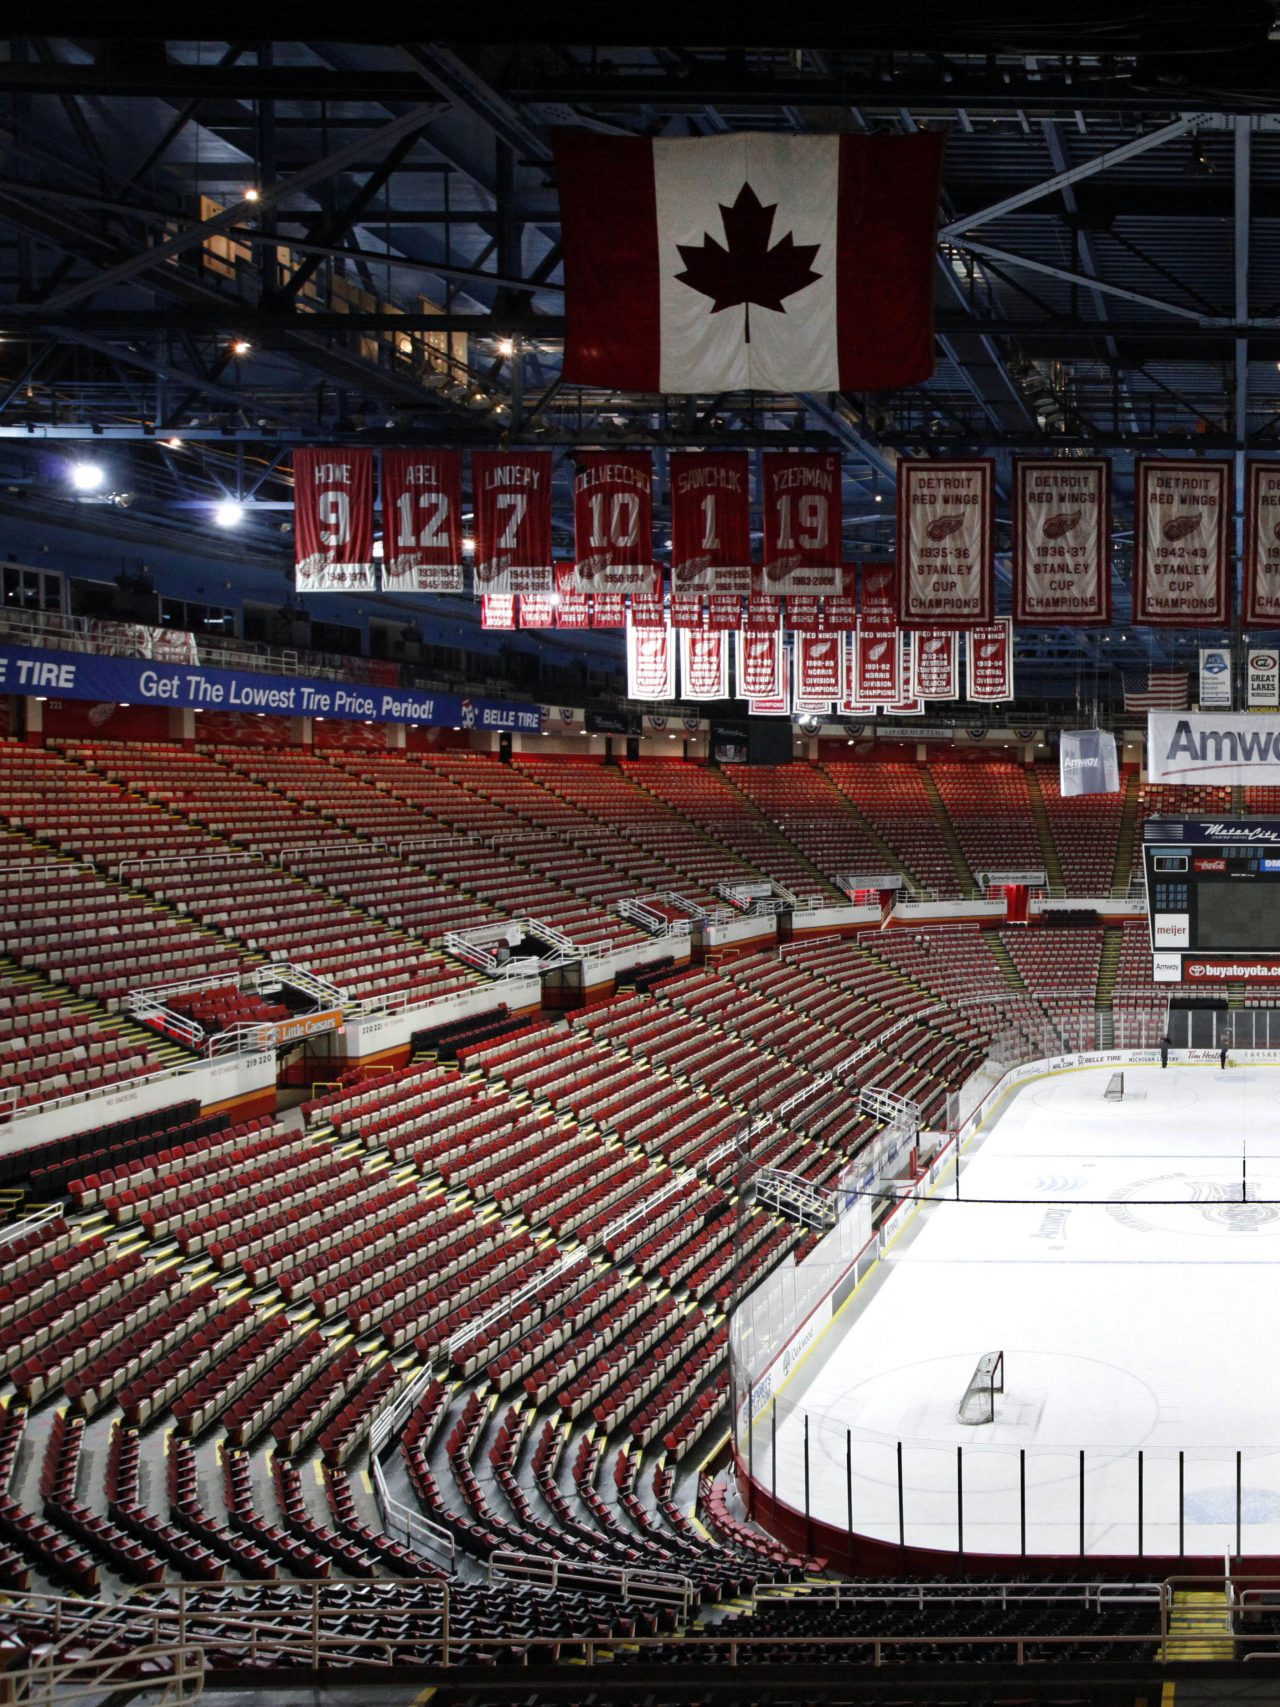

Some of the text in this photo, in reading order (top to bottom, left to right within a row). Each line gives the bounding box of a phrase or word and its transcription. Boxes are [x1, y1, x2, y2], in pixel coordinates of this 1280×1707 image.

[826, 458, 834, 470] C
[315, 465, 351, 484] HOWE
[406, 465, 437, 485] ABEL
[486, 466, 540, 490] LINDSAY
[576, 464, 650, 494] DELVECCHIO
[678, 467, 741, 493] SAWCHUK
[773, 468, 832, 492] YZERMAN
[919, 478, 972, 489] DETROIT
[1035, 476, 1089, 487] DETROIT
[1157, 478, 1210, 489] DETROIT
[912, 494, 979, 505] RED WINGS
[1028, 493, 1096, 503] RED WINGS
[1150, 494, 1217, 506] RED WINGS
[320, 491, 350, 545] 9
[397, 492, 449, 547] 12
[497, 494, 527, 548] 7
[589, 493, 640, 547] 10
[701, 495, 720, 549] 1
[776, 494, 828, 549] 19
[920, 548, 970, 559] 1935-36
[1037, 547, 1087, 557] 1936-37
[1156, 548, 1208, 558] 1942-43
[510, 570, 550, 579] 1944-1957
[918, 565, 973, 575] STANLEY
[1034, 564, 1089, 574] STANLEY
[1154, 565, 1209, 575] STANLEY
[933, 582, 957, 592] CUP
[1050, 581, 1074, 591] CUP
[1169, 582, 1194, 592] CUP
[911, 598, 979, 608] CHAMPIONS
[1028, 597, 1096, 608] CHAMPIONS
[1148, 598, 1215, 608] CHAMPIONS
[16, 660, 76, 688] TIRE
[1251, 683, 1276, 691] LAKES
[140, 671, 434, 719] Get The Lowest Tire Price, Period!
[483, 709, 539, 727] BELLE TIRE
[1064, 756, 1099, 768] Amway
[1157, 925, 1186, 936] meijer
[1156, 963, 1179, 971] Amway
[283, 1018, 336, 1040] Little Caesars
[362, 1026, 373, 1035] 220
[246, 1055, 272, 1068] 219 220
